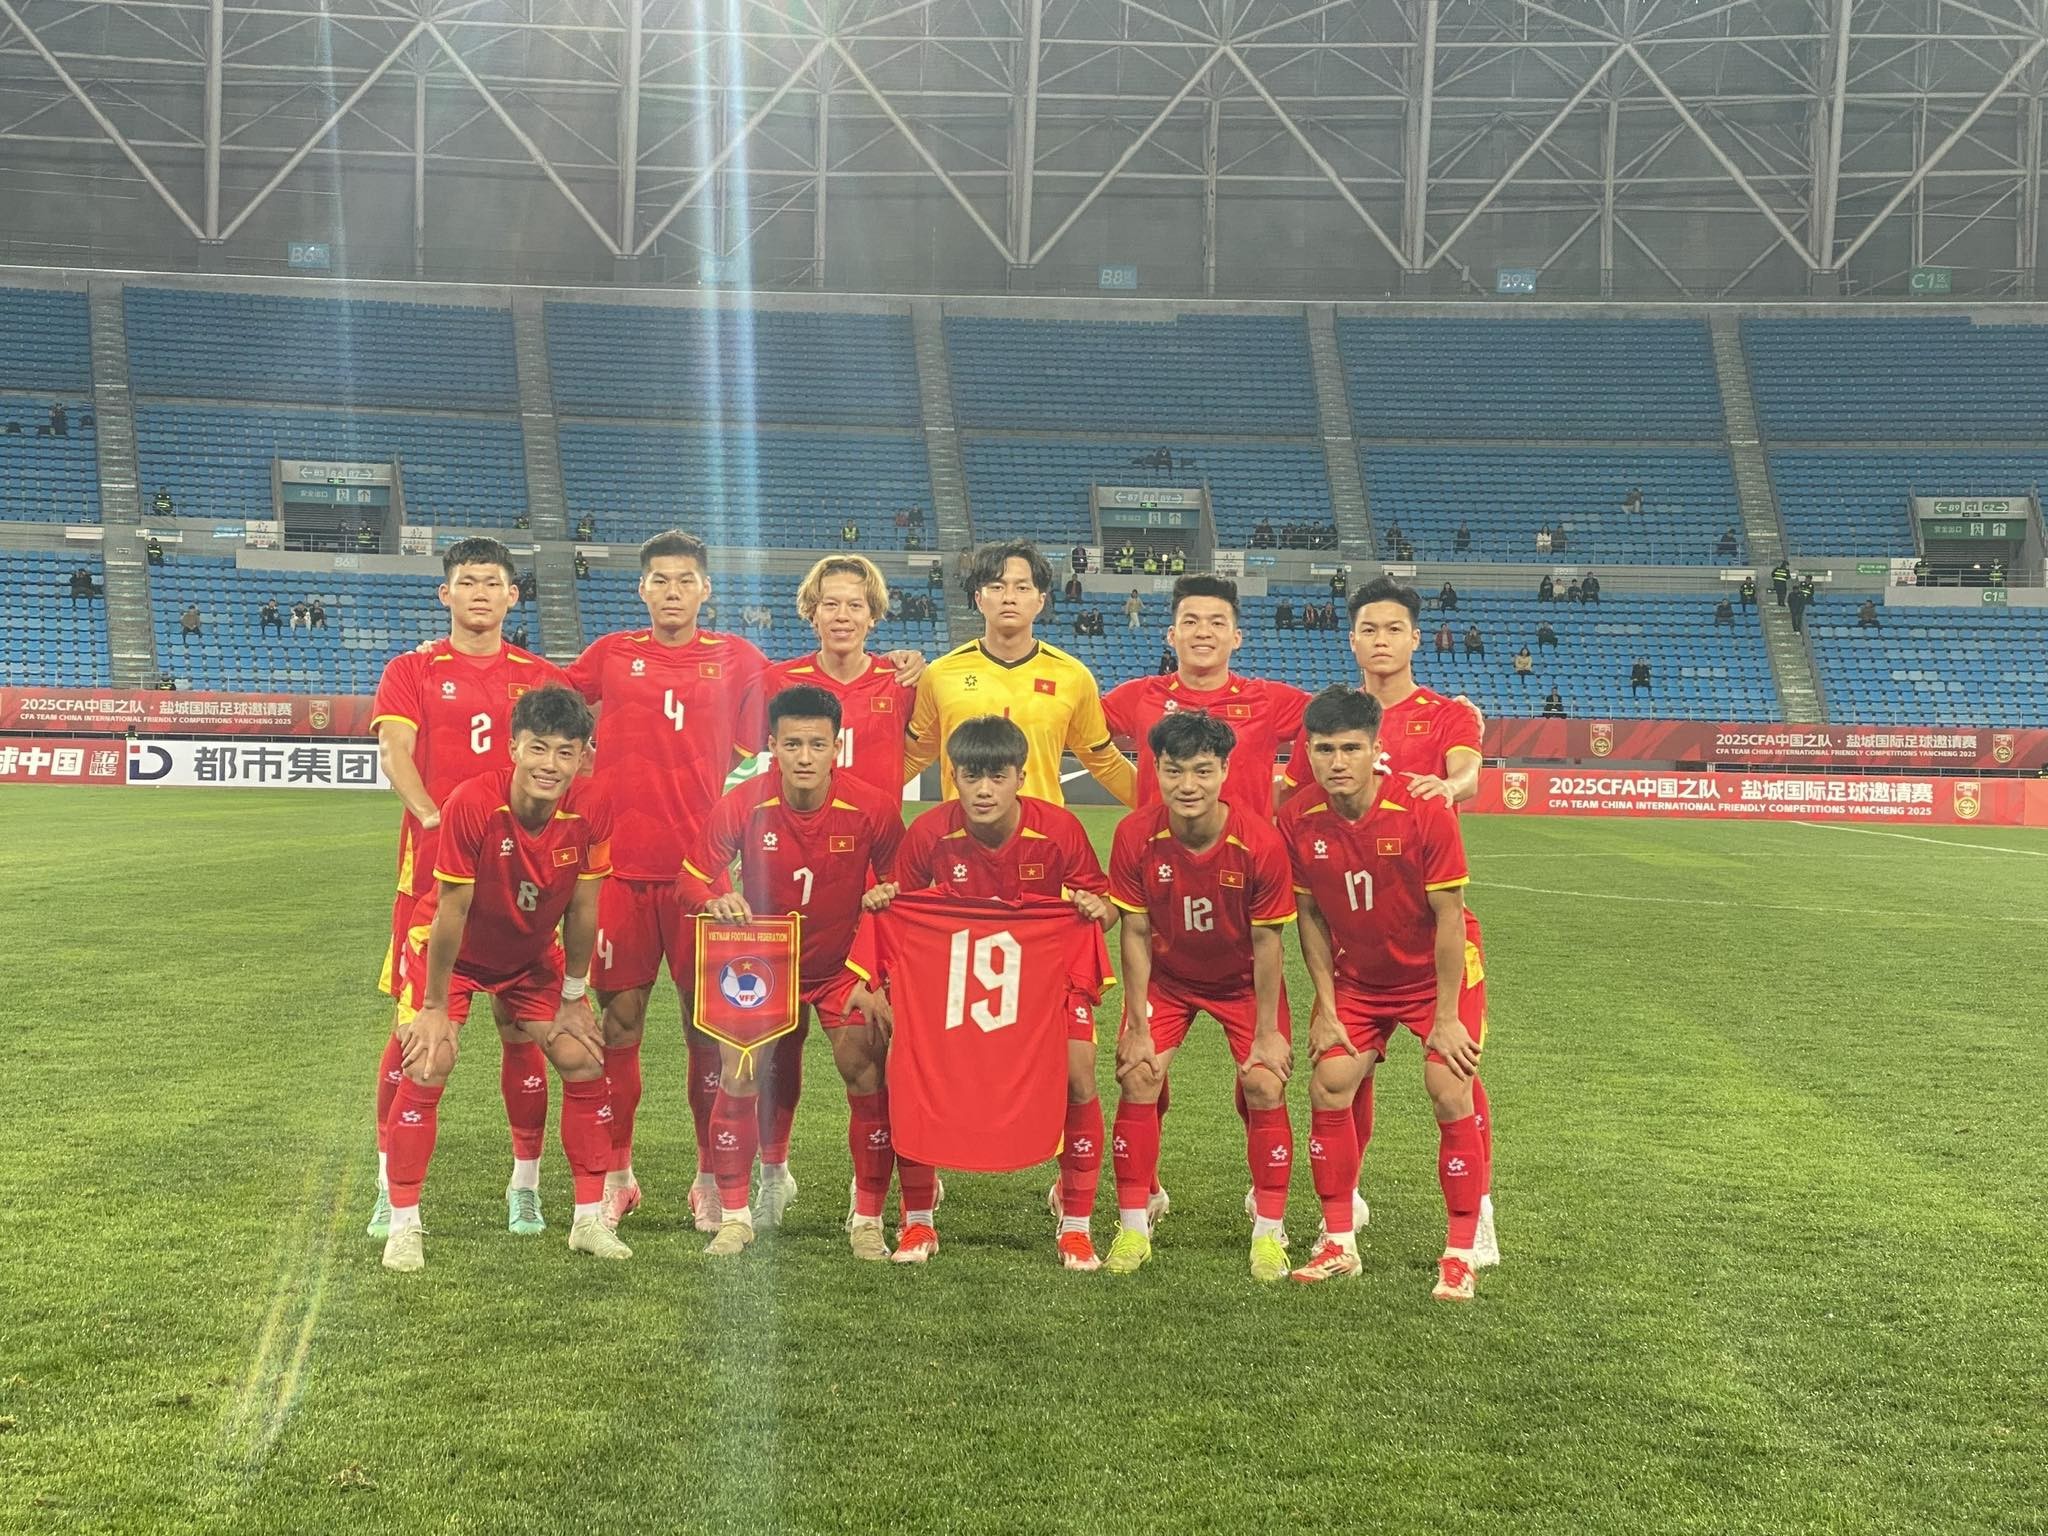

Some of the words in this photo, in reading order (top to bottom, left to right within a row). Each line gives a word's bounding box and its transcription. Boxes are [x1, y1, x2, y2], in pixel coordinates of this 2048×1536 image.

[84, 715, 141, 723] INTERNATIONAL
[143, 716, 177, 724] FRIENDLY
[179, 717, 232, 725] COMPETITIONS
[234, 717, 273, 725] YANCHENG
[664, 689, 684, 731] 4
[470, 712, 491, 754] 2
[194, 747, 378, 784] 都市集团
[1775, 749, 1829, 757] INTERNATIONAL
[1865, 750, 1918, 758] COMPETITIONS
[1919, 750, 1958, 758] YANCHENG
[1549, 799, 1568, 808] CFA
[1572, 800, 1599, 808] TEAM
[1601, 800, 1633, 809] CHINA
[1636, 801, 1716, 811] INTERNATIONAL
[1718, 803, 1766, 812] FRIENDLY
[1768, 804, 1846, 814] COMPETITIONS
[1848, 805, 1905, 815] YANCHENG
[1907, 807, 1932, 816] 2025
[516, 880, 539, 911] 8
[793, 866, 814, 906] 7
[1344, 869, 1374, 912] 17
[1183, 895, 1214, 931] 12
[709, 931, 730, 941] VIETNAM
[730, 931, 756, 941] FOOTBALL
[945, 928, 1022, 1033] 19
